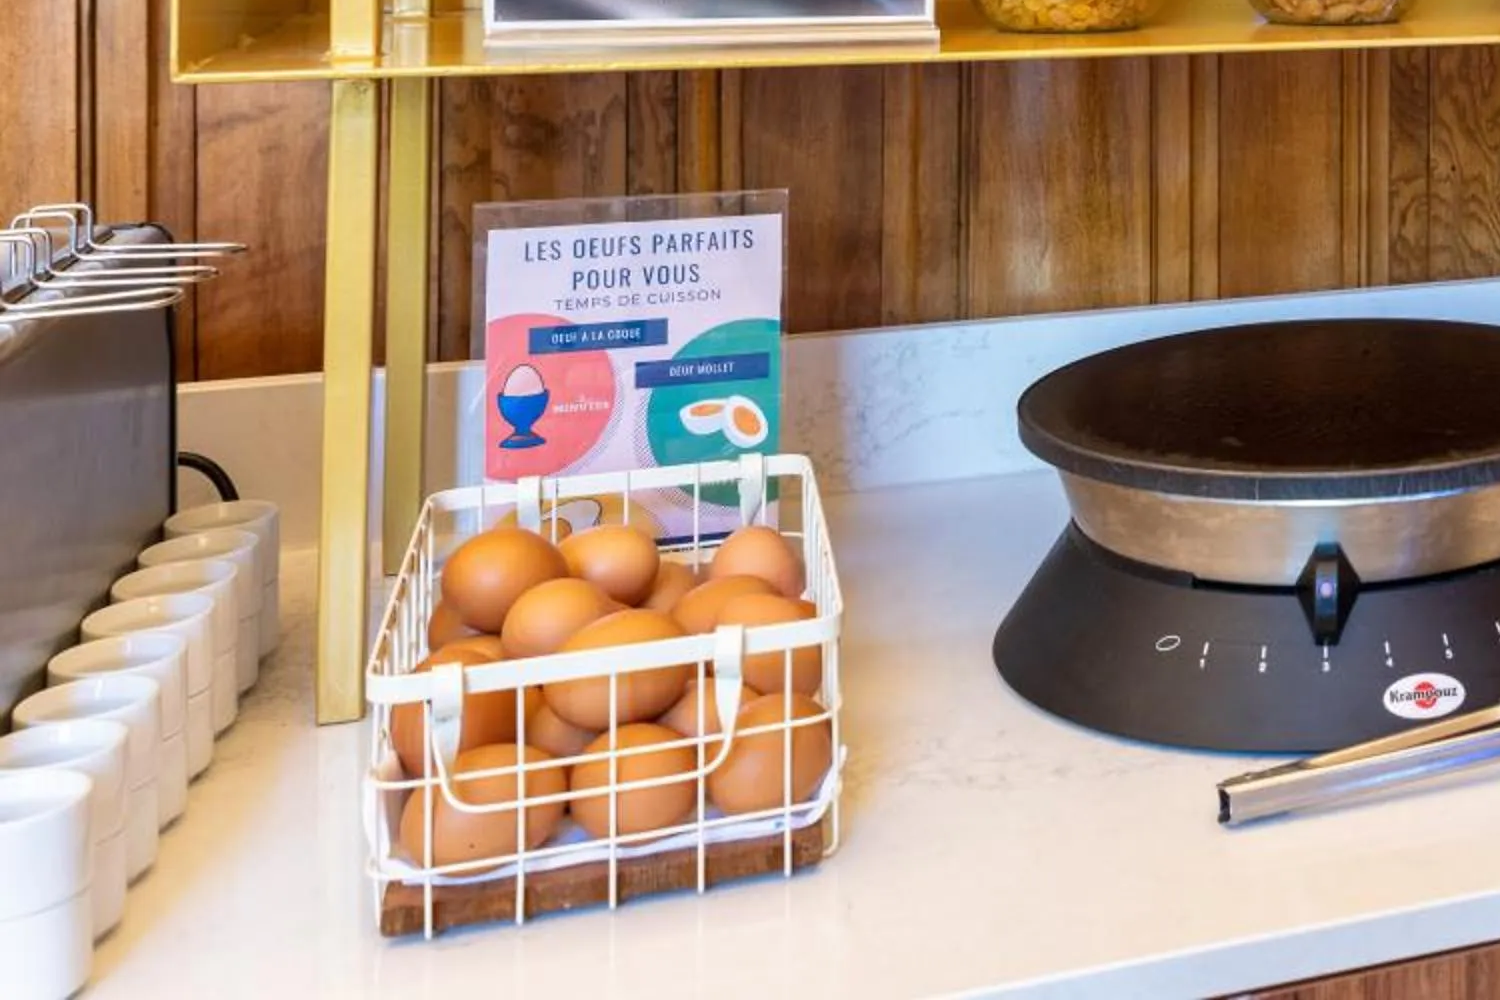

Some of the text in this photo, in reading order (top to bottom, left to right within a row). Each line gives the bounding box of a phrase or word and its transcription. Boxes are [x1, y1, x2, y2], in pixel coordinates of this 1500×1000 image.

[524, 229, 754, 262] LES OEUFS PARFAITS
[572, 264, 700, 291] POUR VOUS
[554, 289, 722, 310] TEMPS DE CUISSON
